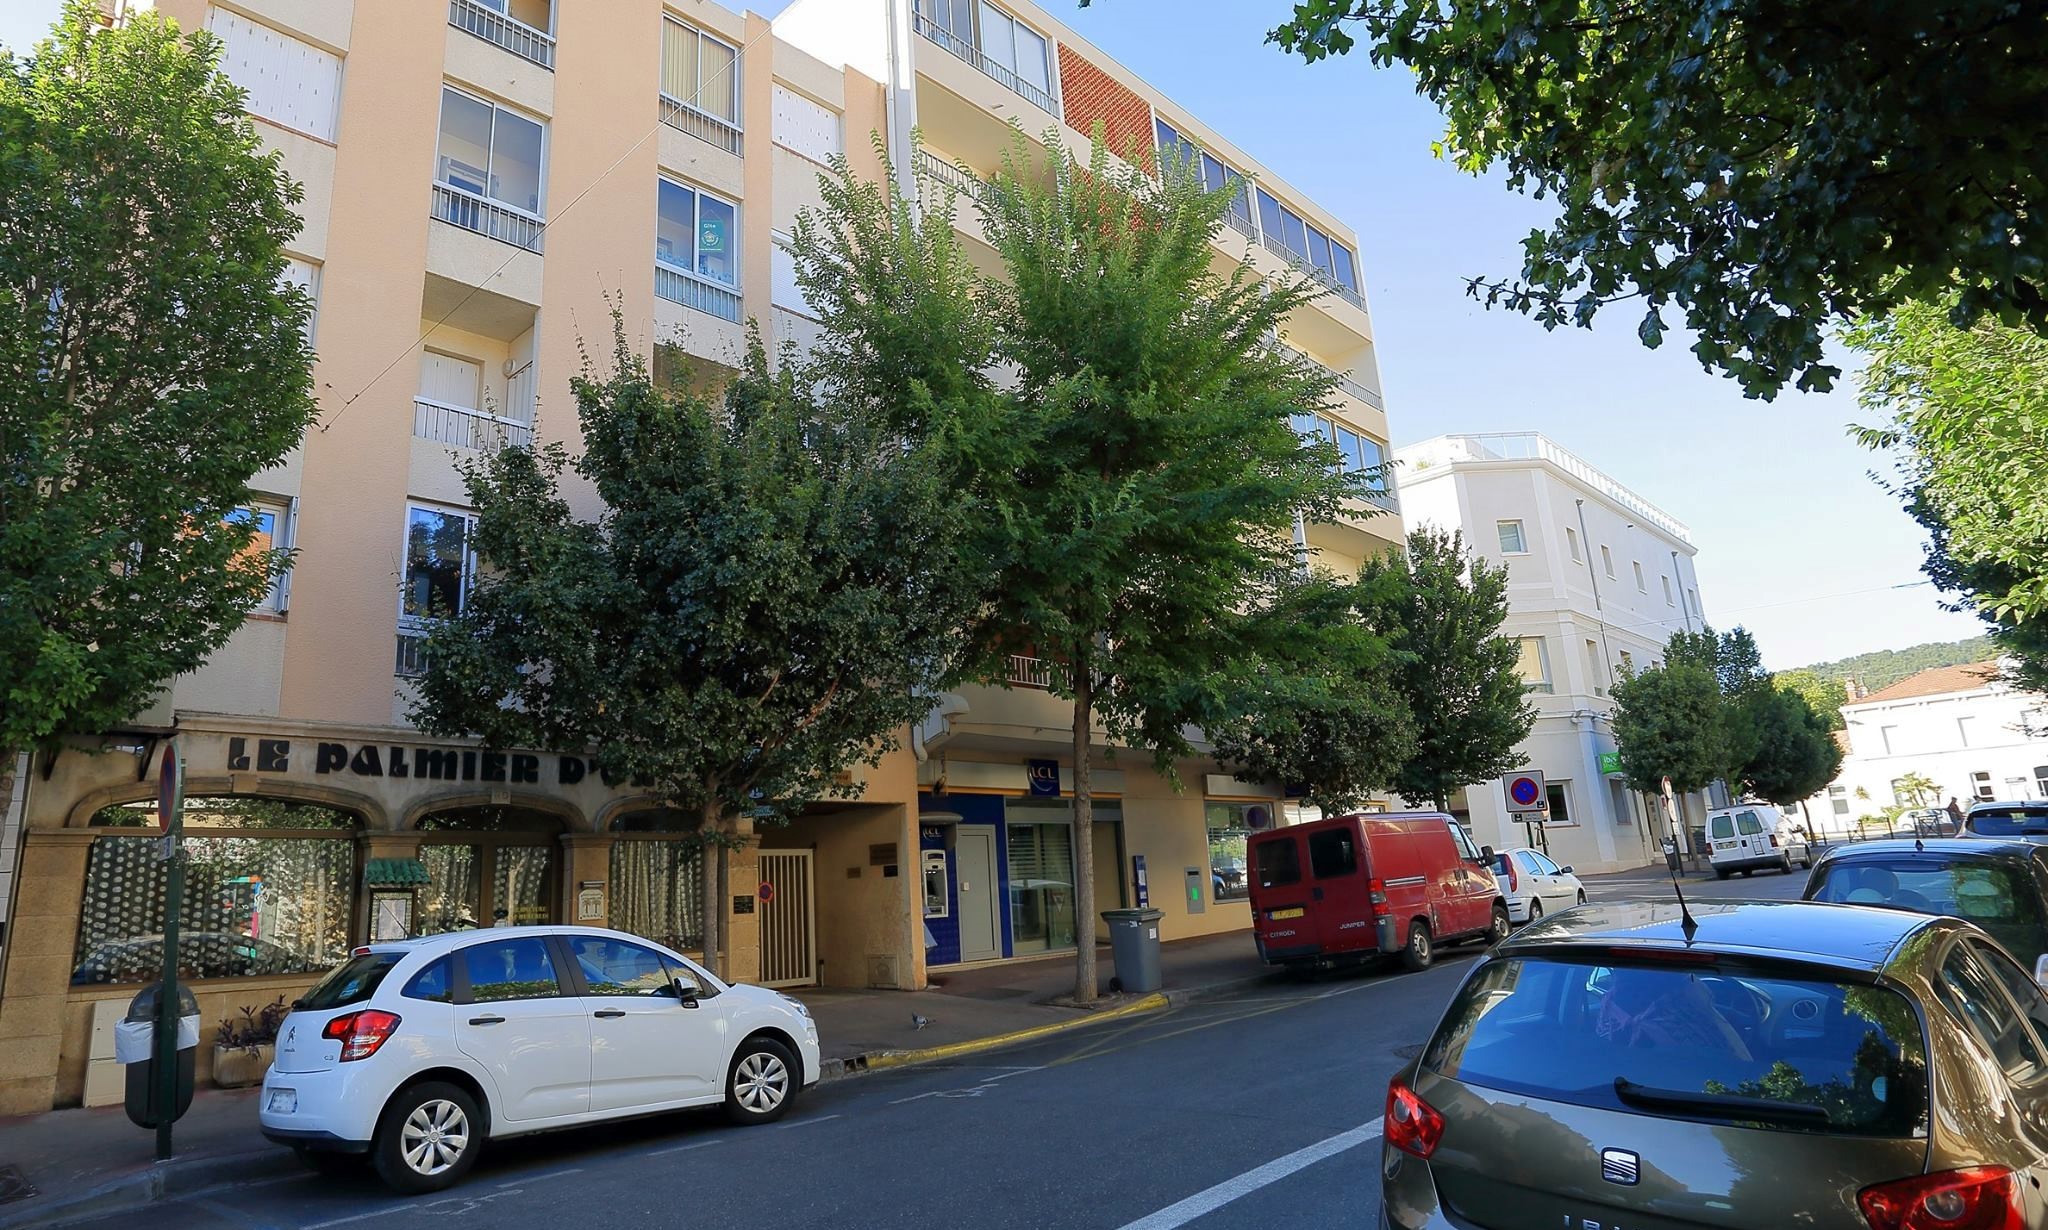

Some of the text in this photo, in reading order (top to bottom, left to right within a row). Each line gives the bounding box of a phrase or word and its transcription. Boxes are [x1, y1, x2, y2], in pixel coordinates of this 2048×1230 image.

[228, 737, 290, 773] LE
[315, 742, 540, 784] PALMIER
[1031, 766, 1056, 779] LCL
[1339, 920, 1366, 930] JUMPER
[1563, 1214, 1621, 1230] IB
